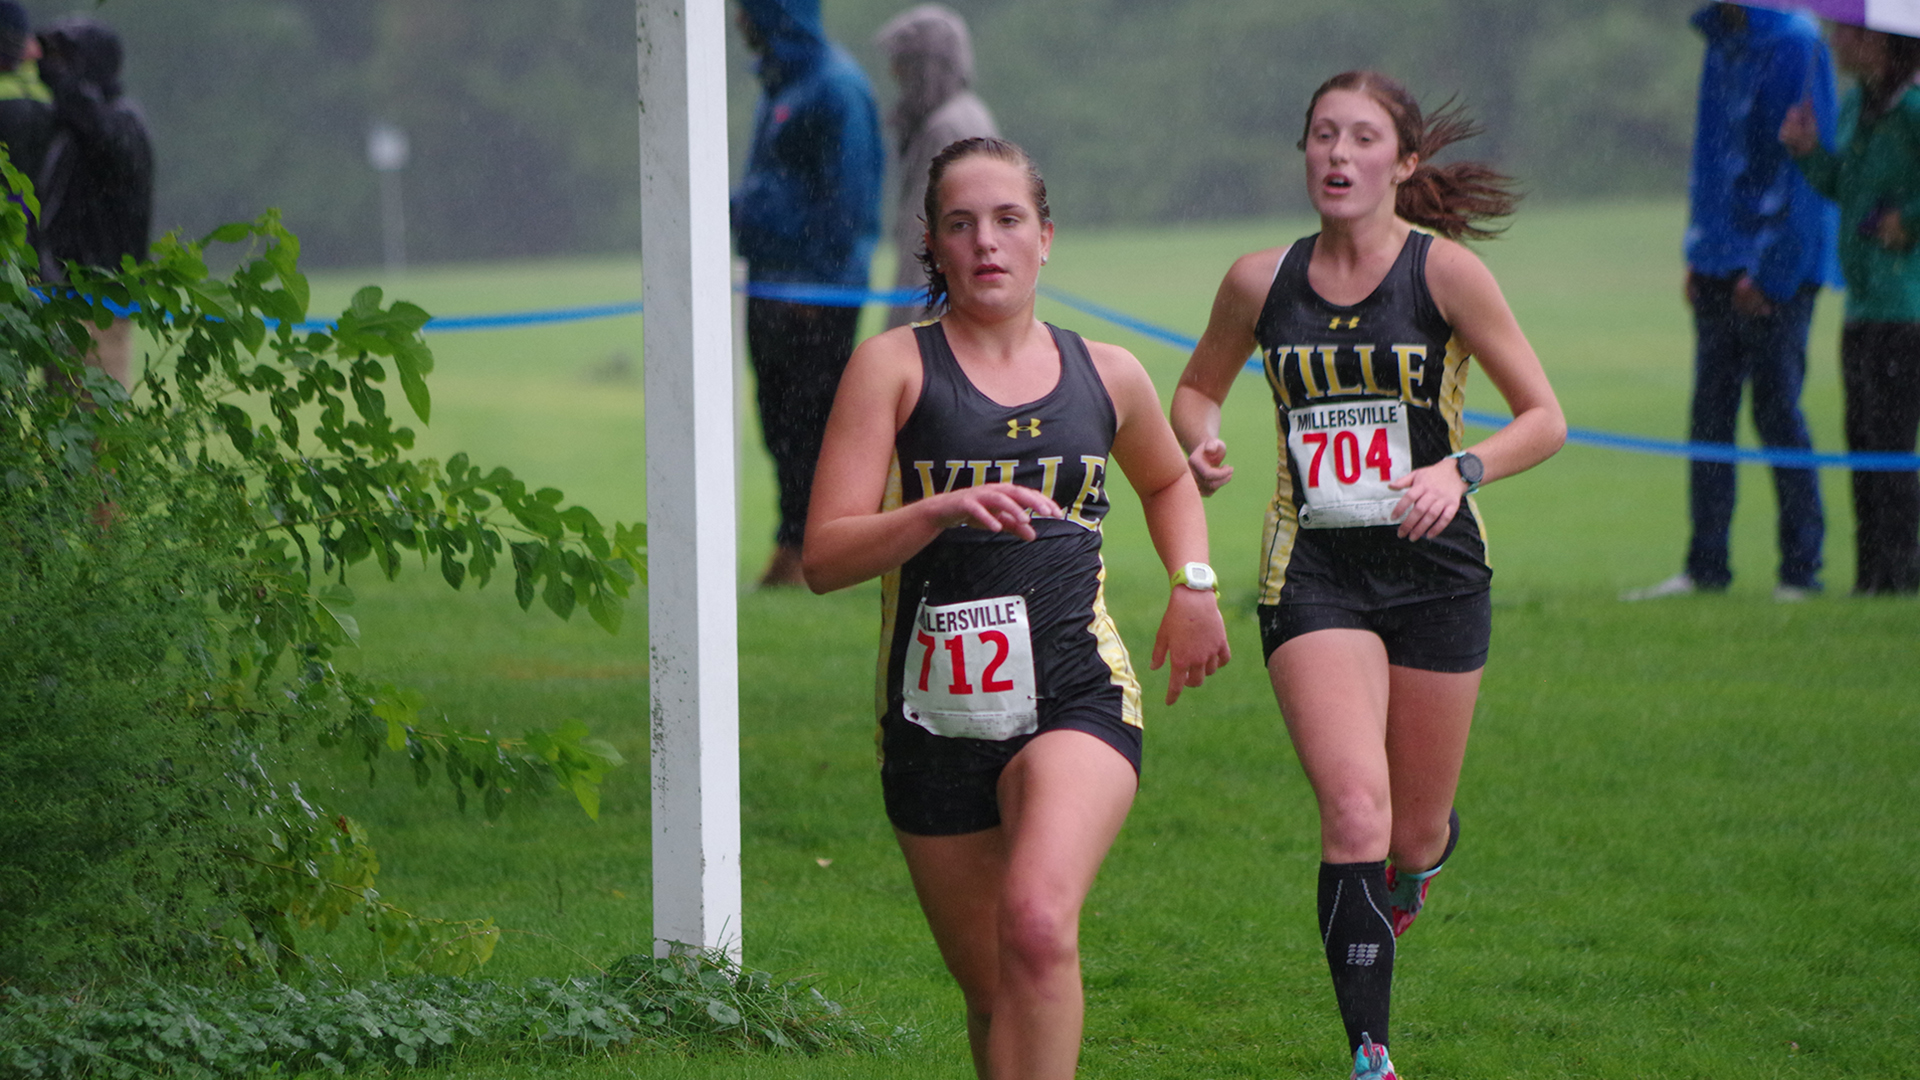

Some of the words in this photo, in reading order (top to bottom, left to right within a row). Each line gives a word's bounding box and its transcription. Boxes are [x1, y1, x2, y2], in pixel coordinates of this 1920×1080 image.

[1263, 344, 1432, 409] VILLE
[1296, 405, 1398, 432] MILLERSVILLE
[1302, 427, 1393, 489] 704
[916, 629, 1014, 695] 712
